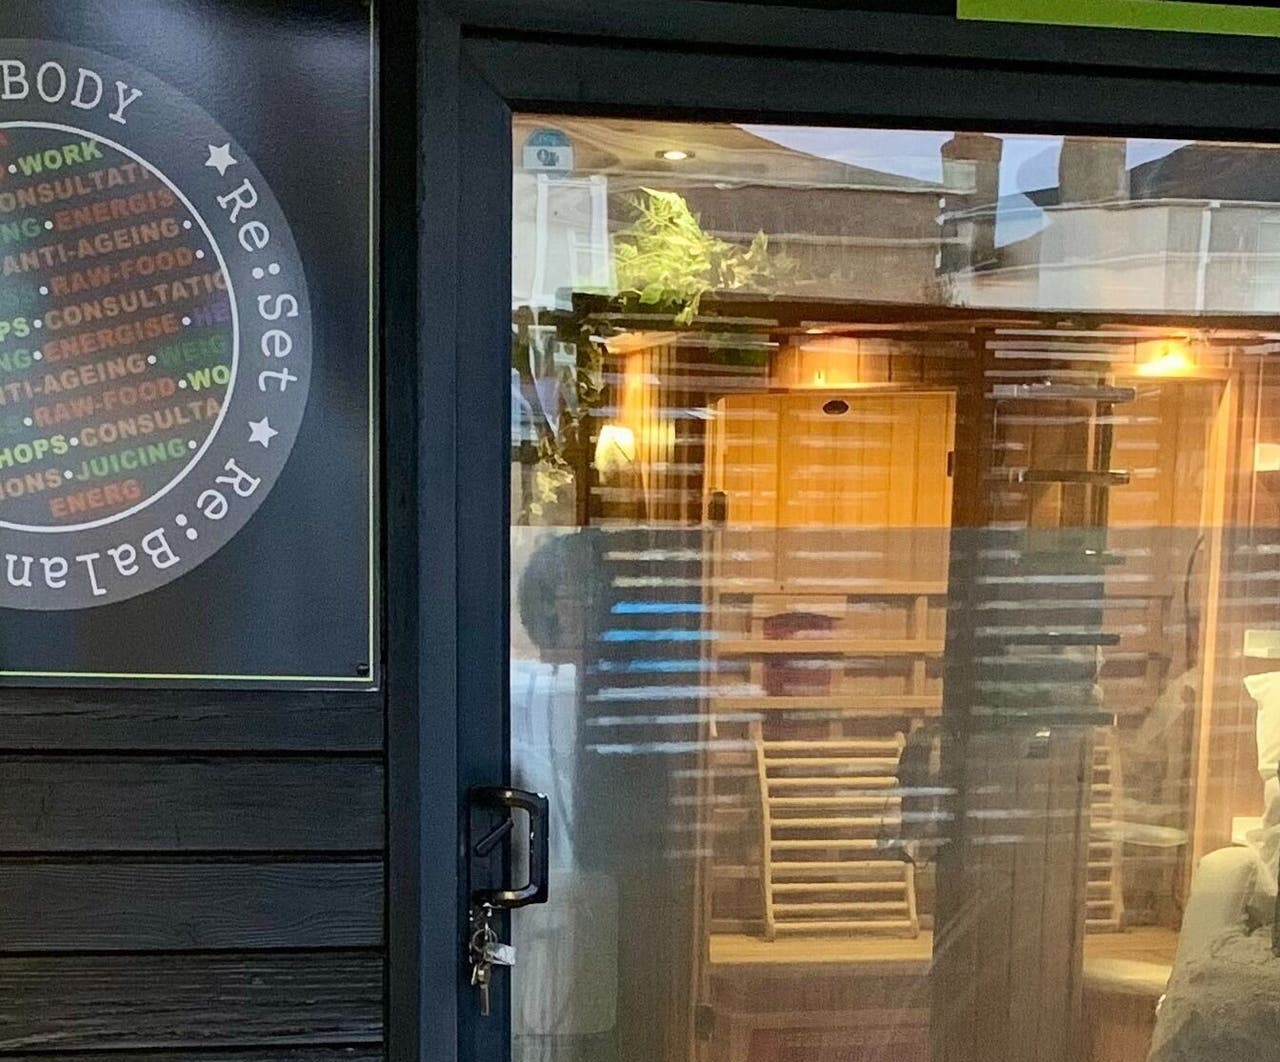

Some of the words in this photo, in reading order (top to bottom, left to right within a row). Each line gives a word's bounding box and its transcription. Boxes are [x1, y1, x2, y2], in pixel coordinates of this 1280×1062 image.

[18, 138, 104, 177] WORK
[2, 217, 181, 277] ANTI-AGEING
[50, 246, 193, 297] RAW-FOOD
[215, 177, 299, 393] Re:Set
[42, 313, 182, 364] ENERGISE
[33, 377, 177, 429] RAW-FOOD
[186, 364, 231, 393] WO
[80, 397, 223, 449] CONSULTA
[75, 438, 188, 482] JUICING
[48, 477, 144, 518] ENERG
